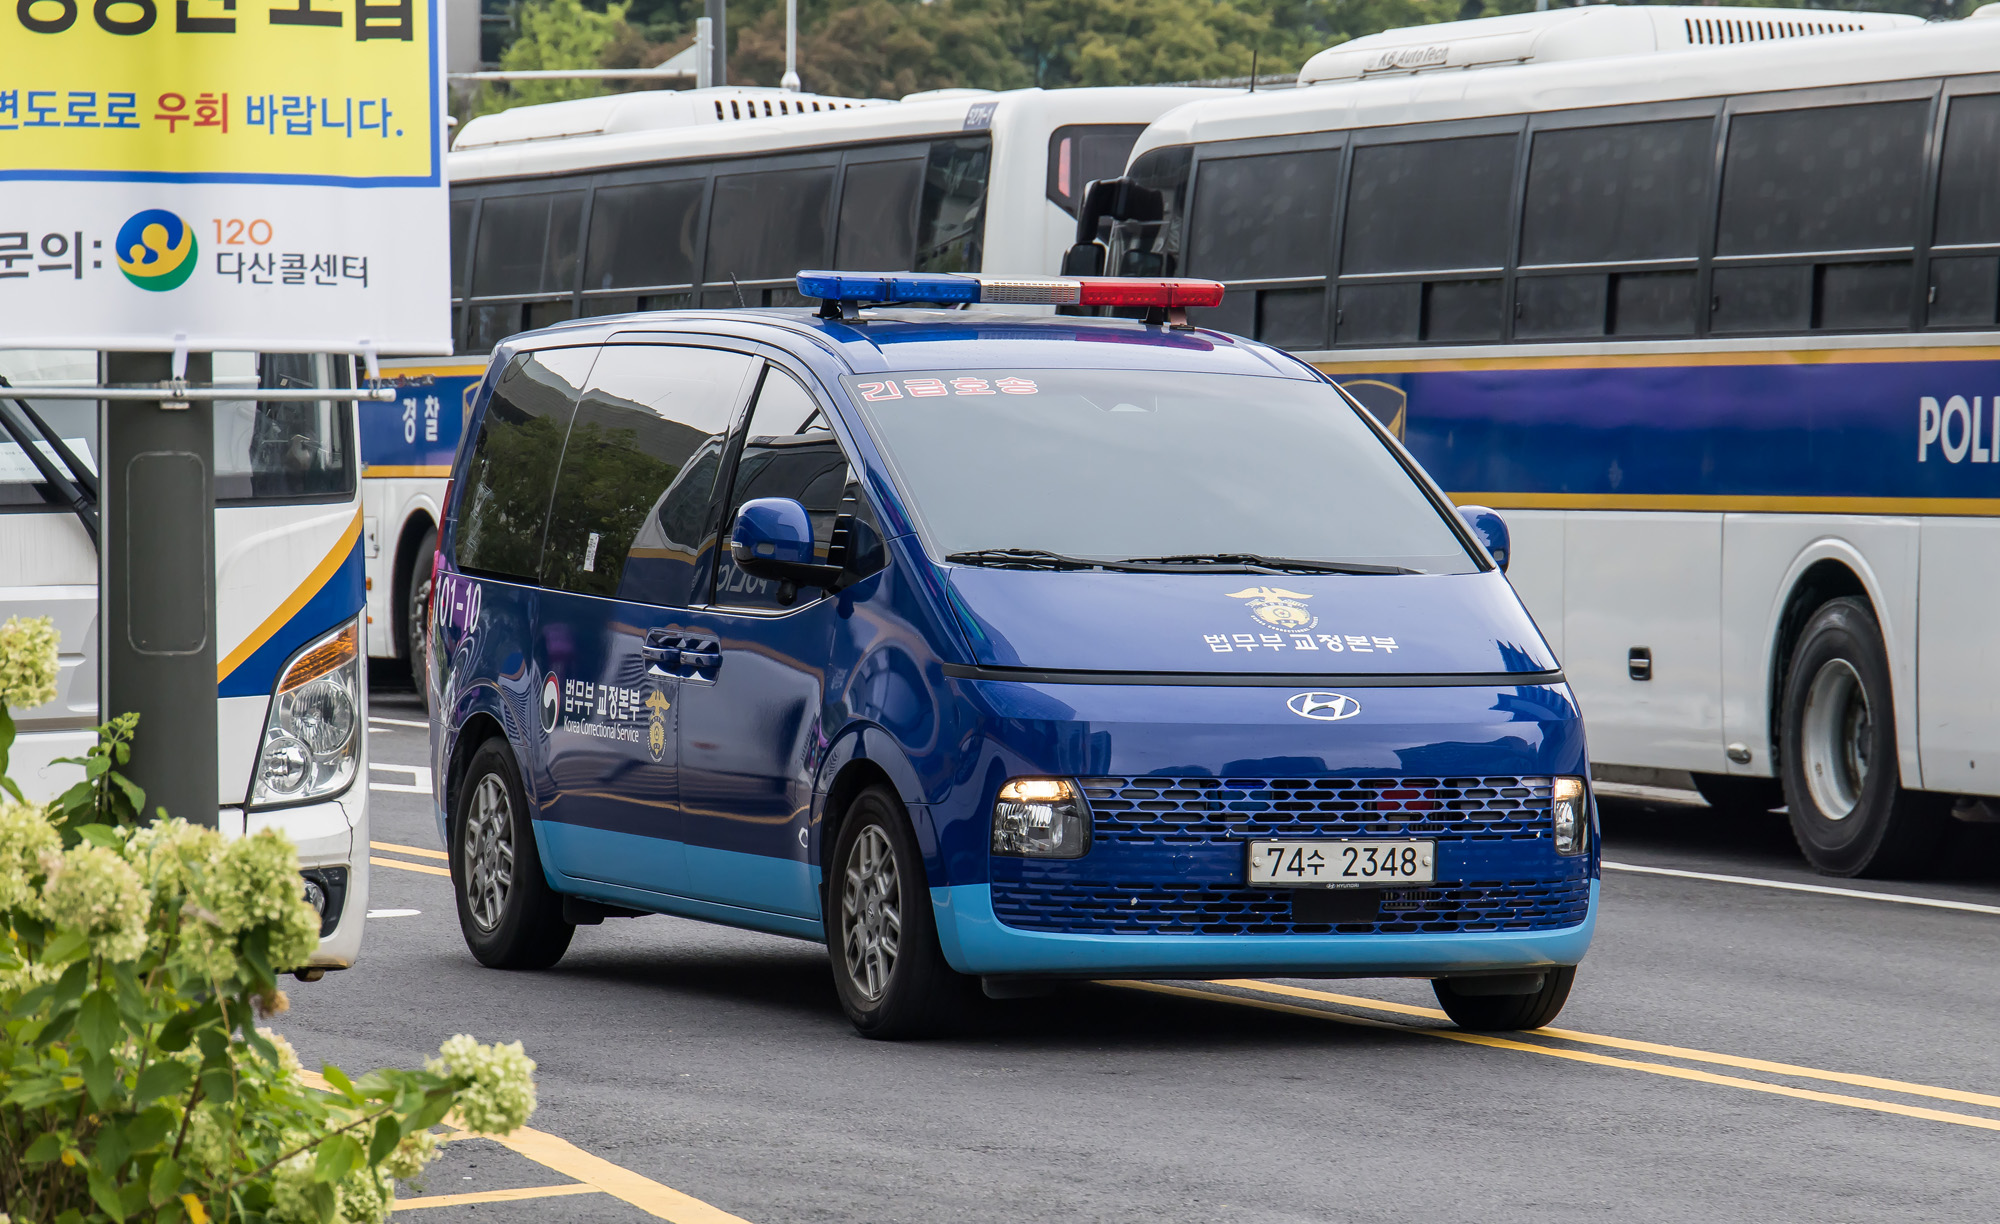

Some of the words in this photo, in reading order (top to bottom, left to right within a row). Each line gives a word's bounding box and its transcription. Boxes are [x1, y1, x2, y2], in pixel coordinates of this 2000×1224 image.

[154, 92, 229, 134] 우회
[246, 94, 404, 139] 바랍니다.
[212, 218, 273, 246] 120
[216, 252, 368, 289] 다산콜센터
[857, 376, 1039, 402] 긴급호송
[402, 394, 440, 444] 경찰
[1919, 394, 2000, 464] POLI
[434, 575, 482, 634] 101-10
[1203, 633, 1287, 653] 법무부
[1289, 633, 1400, 654] 교정본부
[565, 678, 594, 716] 법무부
[597, 684, 640, 721] 교정본부
[564, 715, 580, 735] Korea
[581, 718, 616, 740] Correctional
[616, 723, 640, 743] Service
[1267, 847, 1325, 877] 74수
[1342, 846, 1417, 877] 2348
